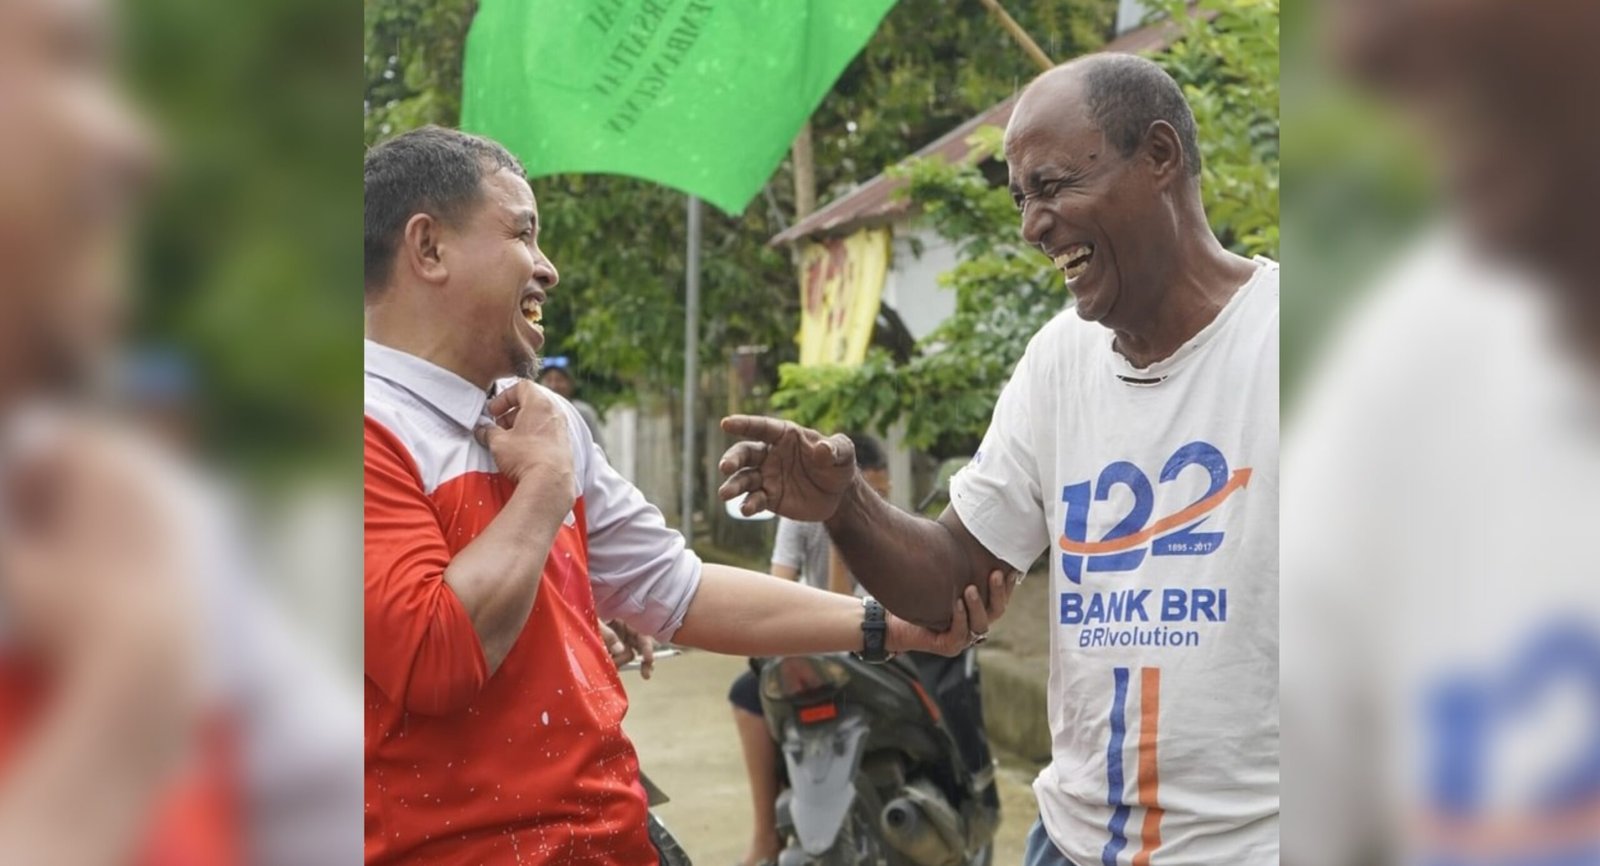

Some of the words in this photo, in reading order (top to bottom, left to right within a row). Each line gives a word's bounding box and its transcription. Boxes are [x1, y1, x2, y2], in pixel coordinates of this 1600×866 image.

[1062, 441, 1229, 585] 122
[1168, 543, 1188, 552] 1895
[1194, 541, 1212, 552] 2017
[1060, 589, 1152, 625] BANK
[1160, 588, 1227, 622] BRI
[1079, 626, 1199, 648] BRIvolution
